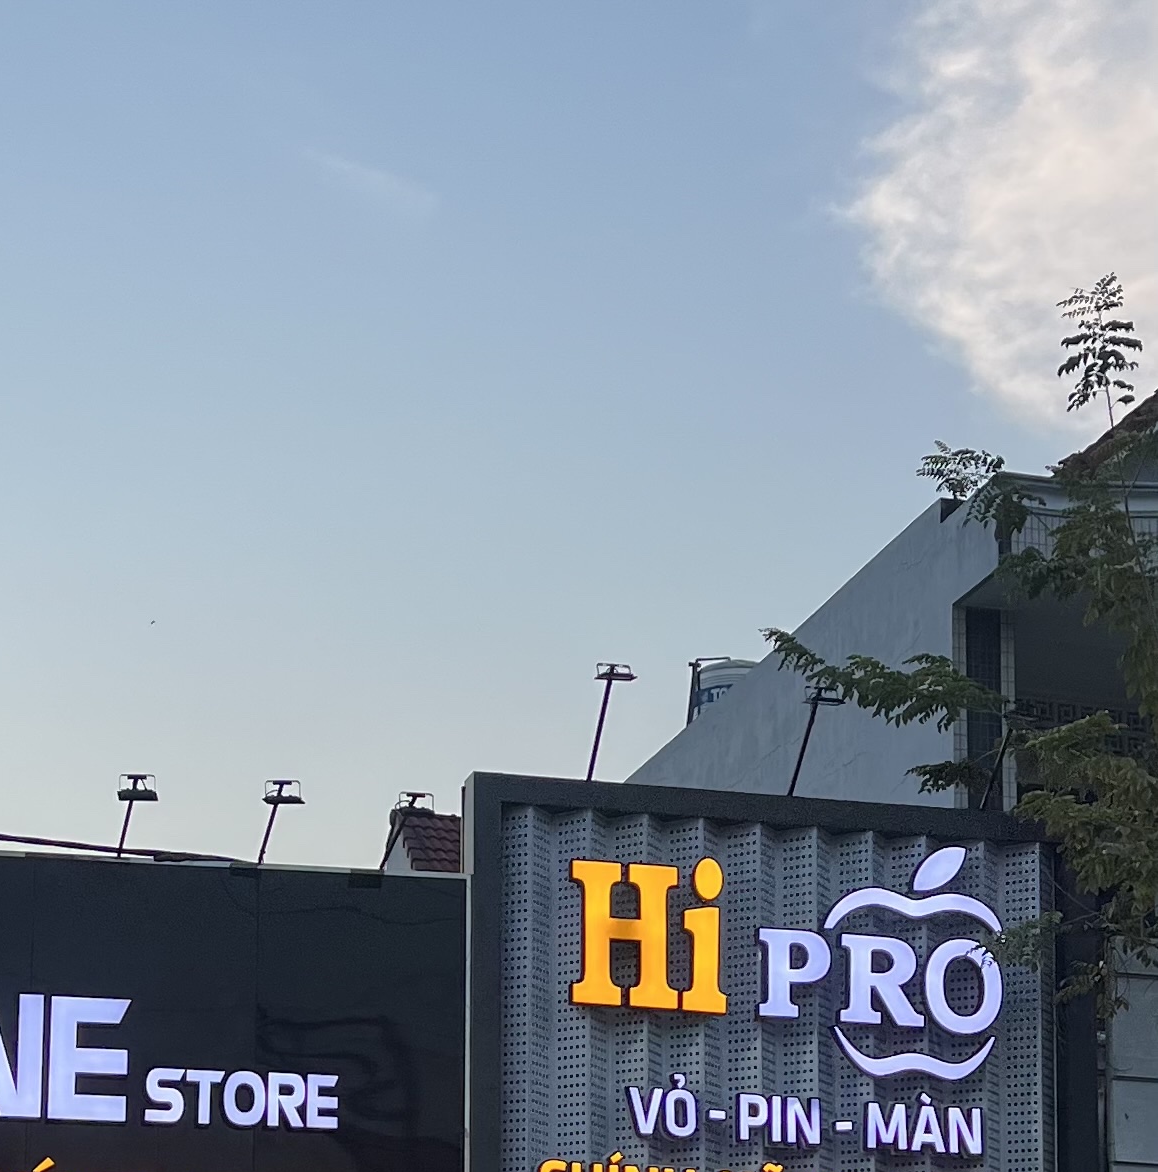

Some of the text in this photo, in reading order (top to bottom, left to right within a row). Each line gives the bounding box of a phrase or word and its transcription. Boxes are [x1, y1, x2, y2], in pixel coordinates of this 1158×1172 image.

[570, 857, 728, 1015] Hi
[757, 926, 1003, 1035] PRO
[144, 1067, 338, 1130] STORE
[627, 1073, 697, 1137] VỎ
[738, 1093, 821, 1145] PIN
[866, 1093, 983, 1155] MÀN
